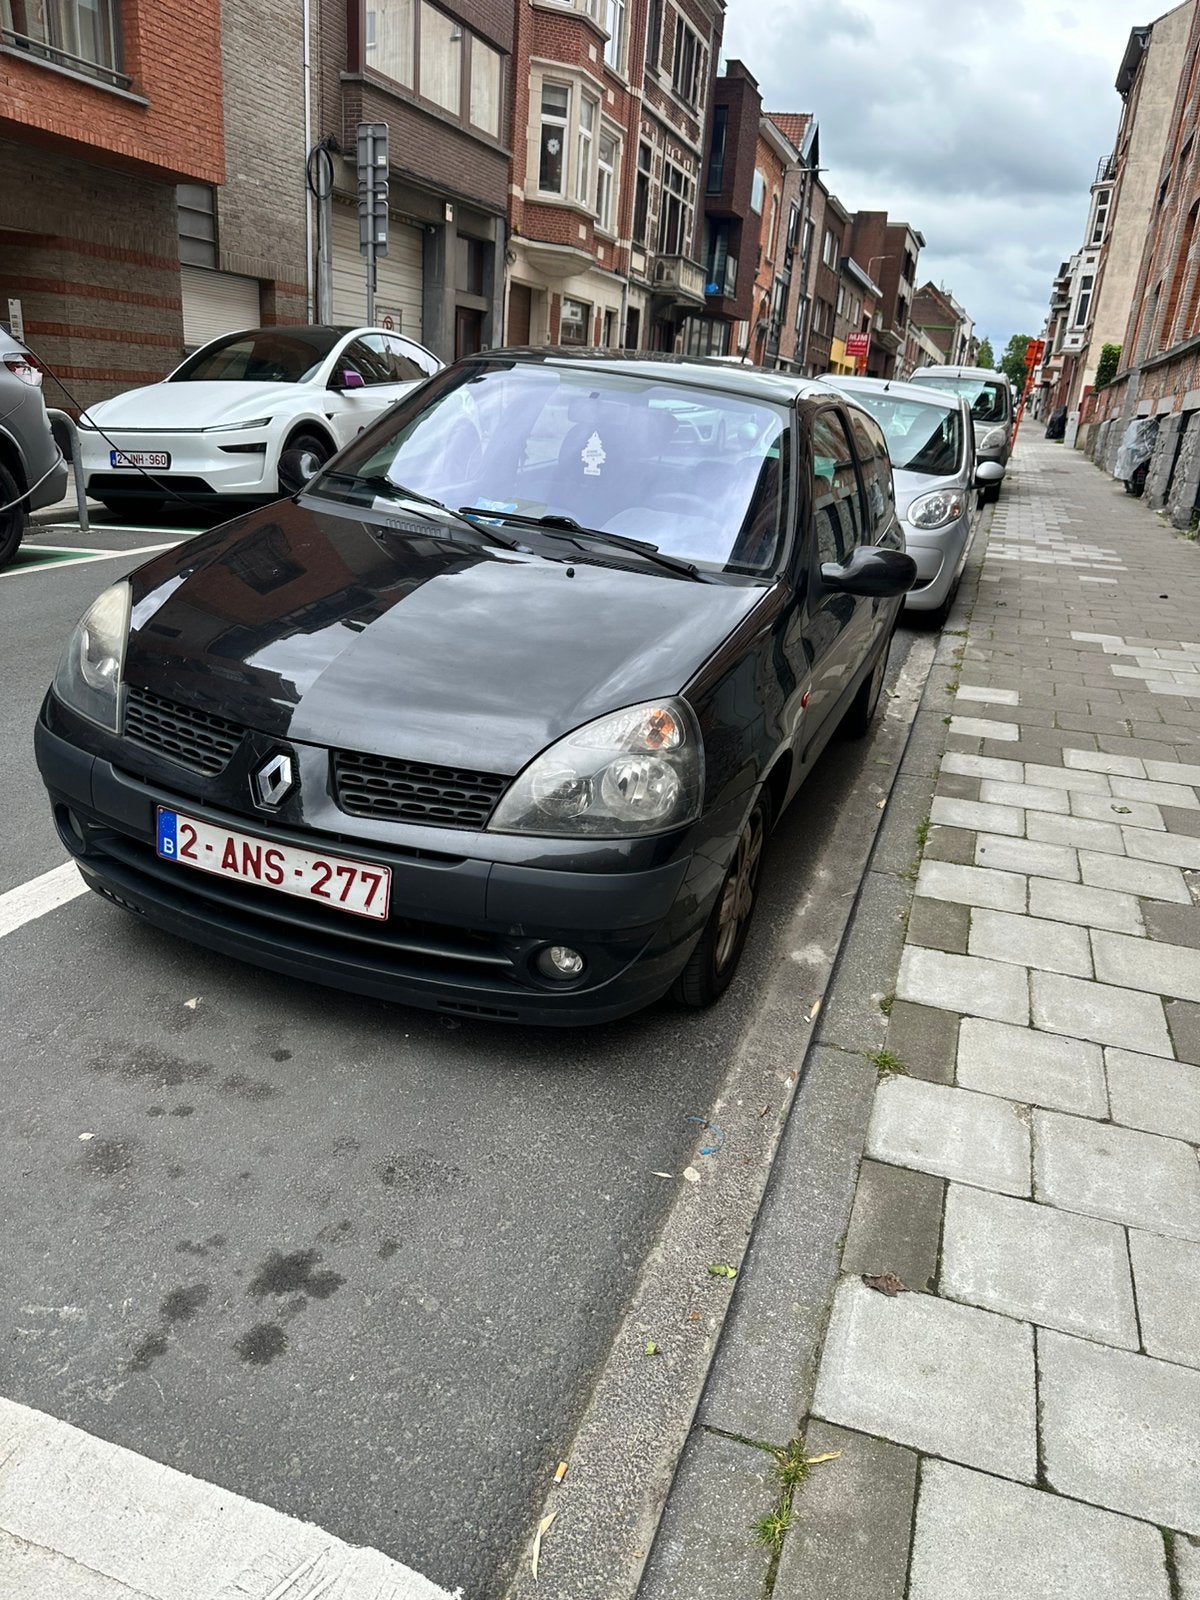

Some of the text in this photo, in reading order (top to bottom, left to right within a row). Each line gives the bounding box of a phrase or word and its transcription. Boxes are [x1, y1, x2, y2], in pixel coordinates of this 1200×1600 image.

[849, 333, 868, 341] MJM
[163, 823, 383, 907] B 2-ANS-277
